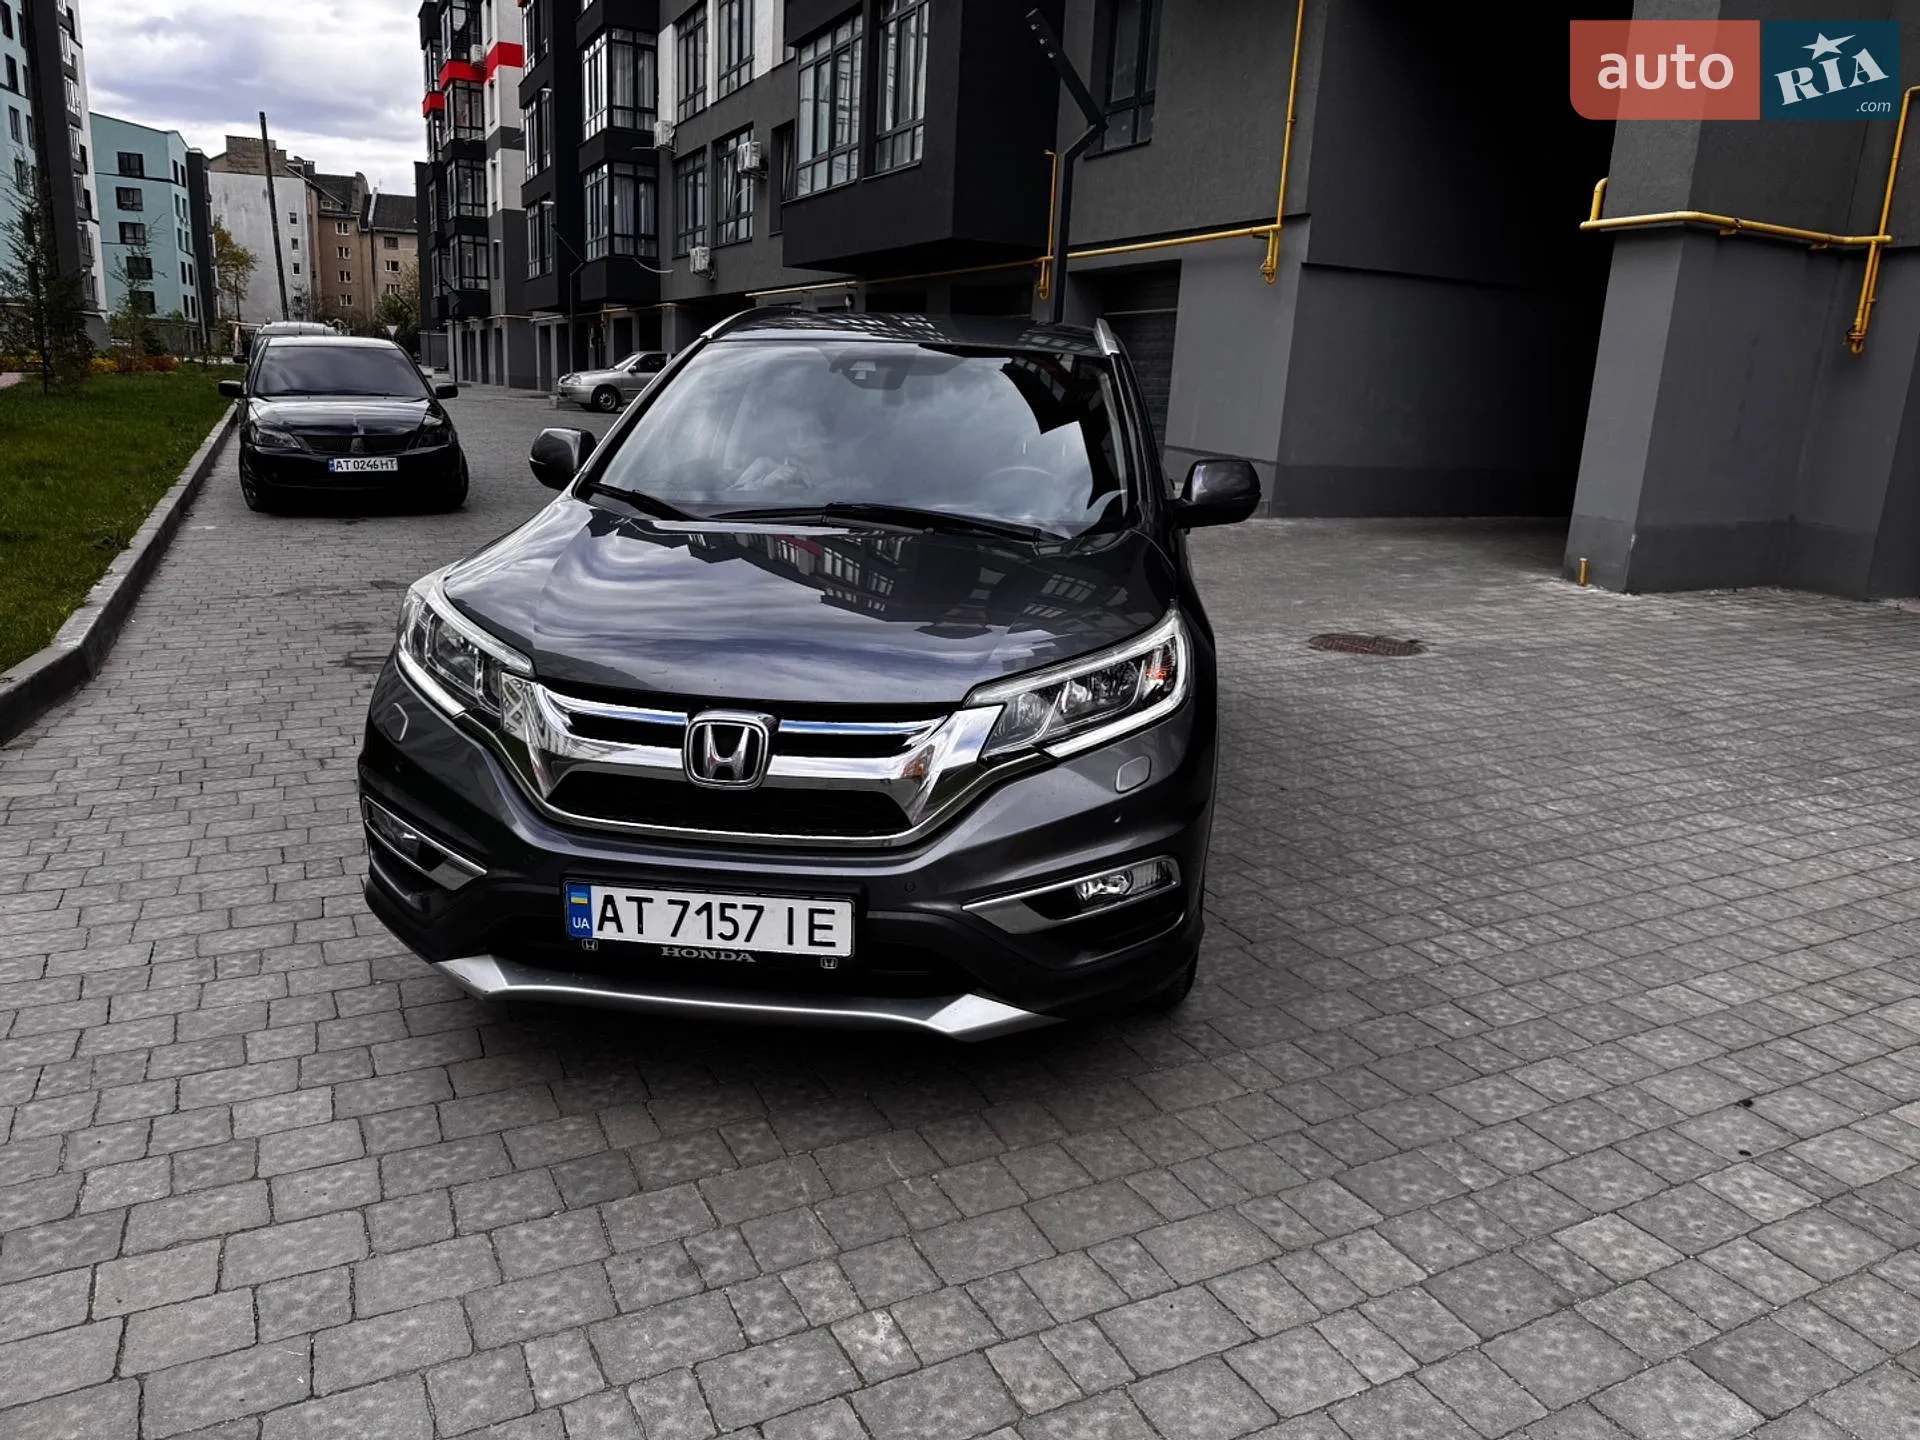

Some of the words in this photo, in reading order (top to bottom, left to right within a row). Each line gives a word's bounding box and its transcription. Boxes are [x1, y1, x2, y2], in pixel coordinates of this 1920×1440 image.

[336, 460, 351, 471] AT
[353, 459, 379, 471] 0246
[380, 459, 396, 470] HT
[572, 917, 591, 930] UA
[597, 894, 654, 935] AT
[667, 899, 765, 943] 7157
[787, 906, 836, 948] IE
[660, 946, 757, 963] HONDA
